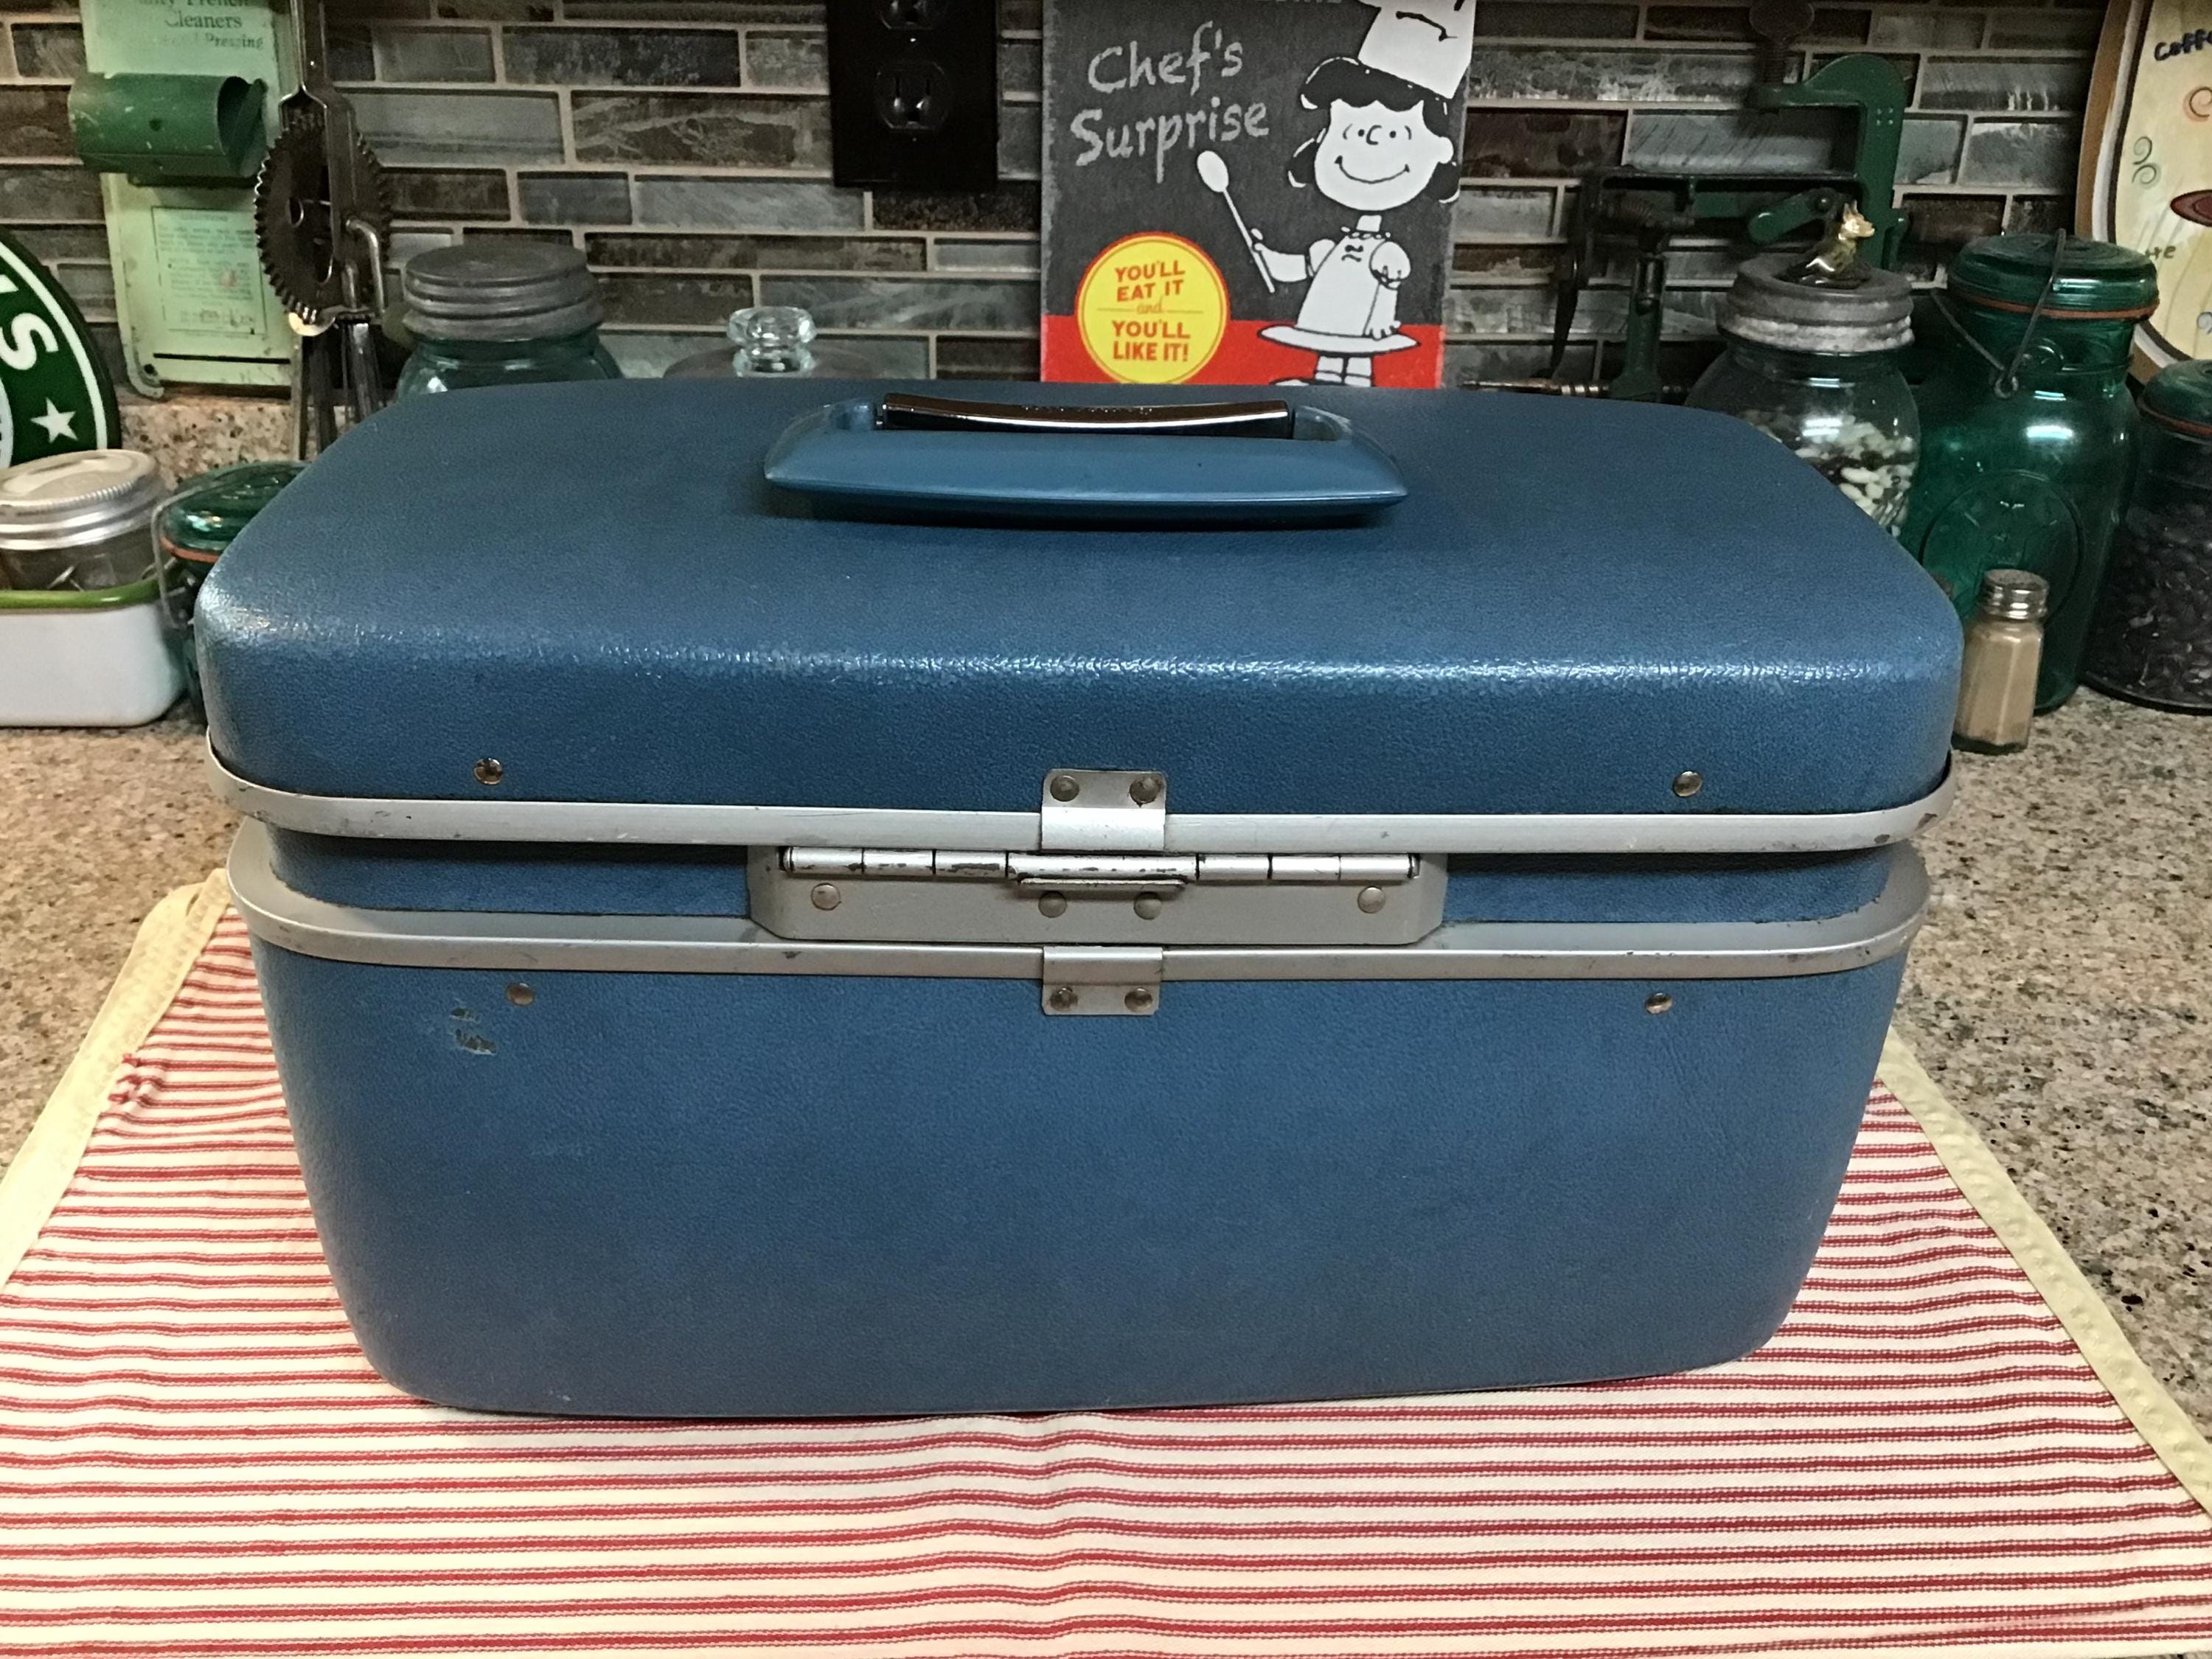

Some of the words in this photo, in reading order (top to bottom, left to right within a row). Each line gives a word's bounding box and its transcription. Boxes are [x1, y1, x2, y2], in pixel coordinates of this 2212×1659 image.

[164, 10, 243, 28] Cleaners
[1088, 21, 1243, 95] Chef's
[1070, 97, 1269, 183] Surprise
[1115, 260, 1186, 282] YOU'LL
[1117, 282, 1155, 302] EAT
[1164, 279, 1184, 296] IT
[1136, 294, 1164, 315] and
[1112, 319, 1191, 339] YOU'LL
[1113, 341, 1158, 361] LIKE
[1163, 343, 1189, 362] IT!
